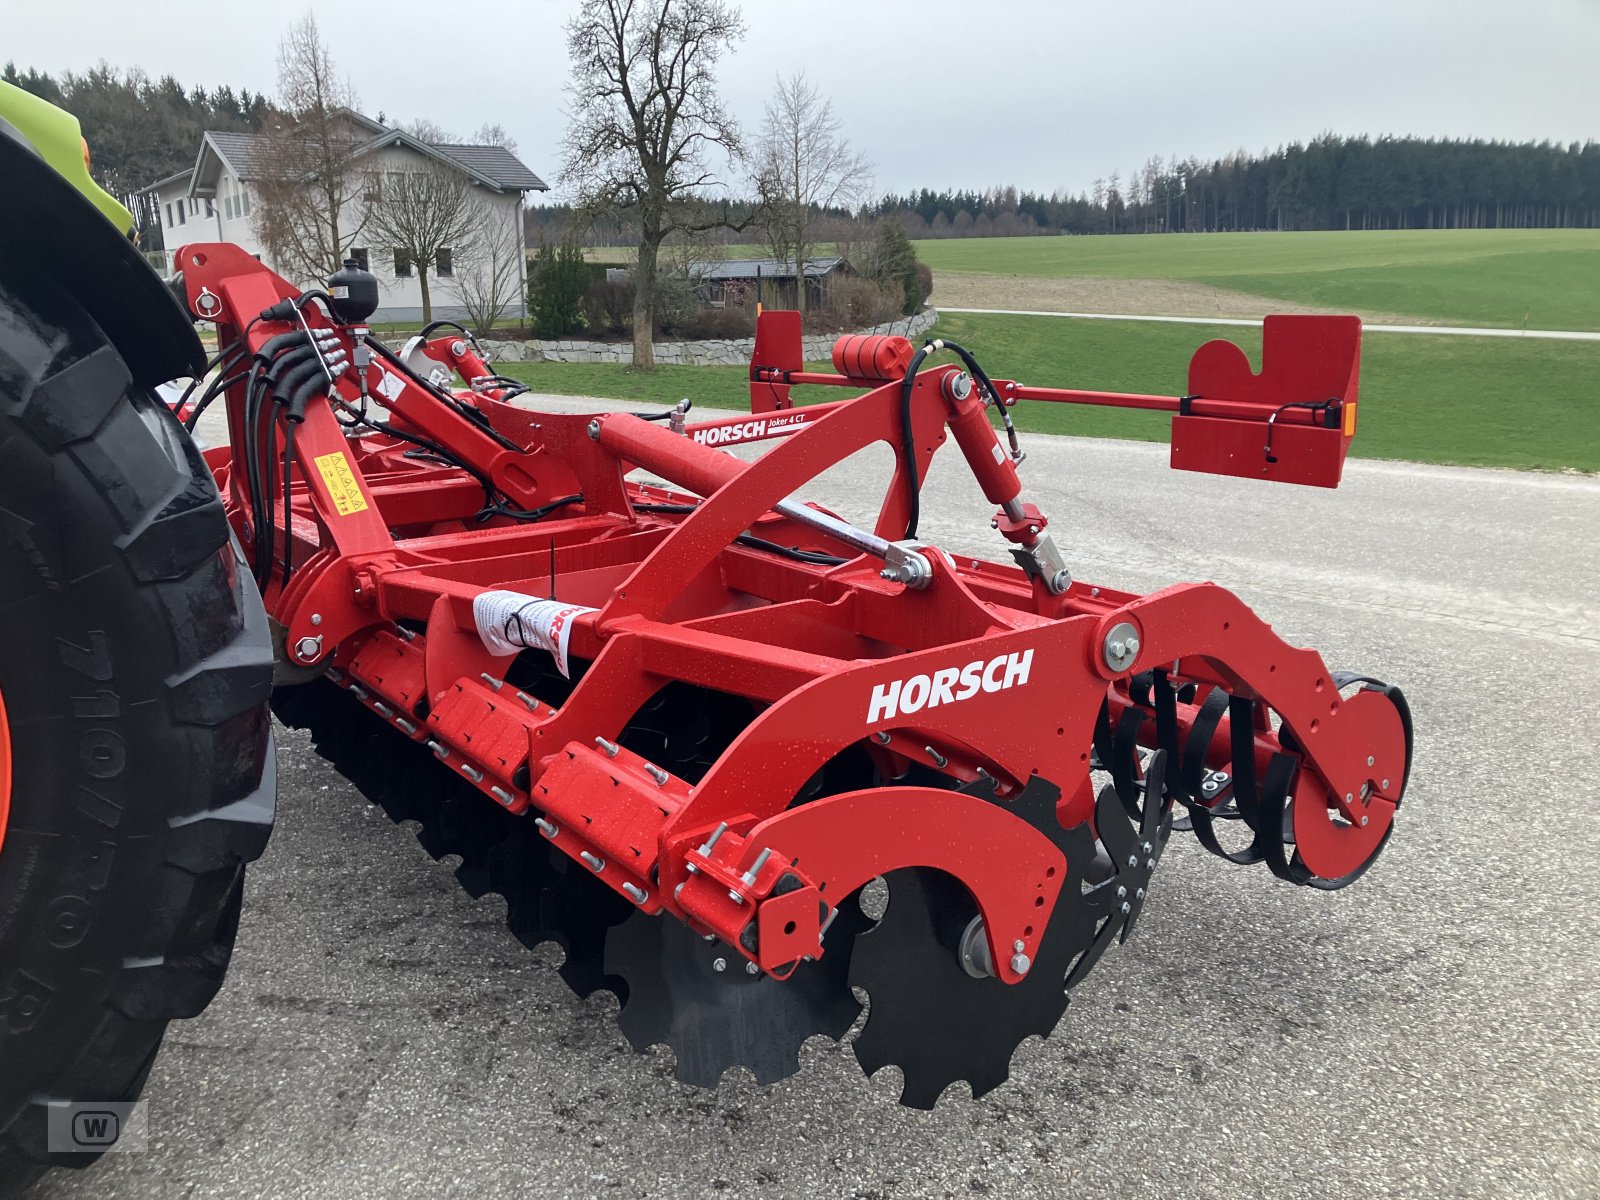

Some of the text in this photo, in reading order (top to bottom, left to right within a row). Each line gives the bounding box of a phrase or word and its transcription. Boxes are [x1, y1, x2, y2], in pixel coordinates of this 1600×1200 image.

[694, 414, 806, 445] HORSCH Joker 4 CT
[866, 648, 1035, 724] HORSCH
